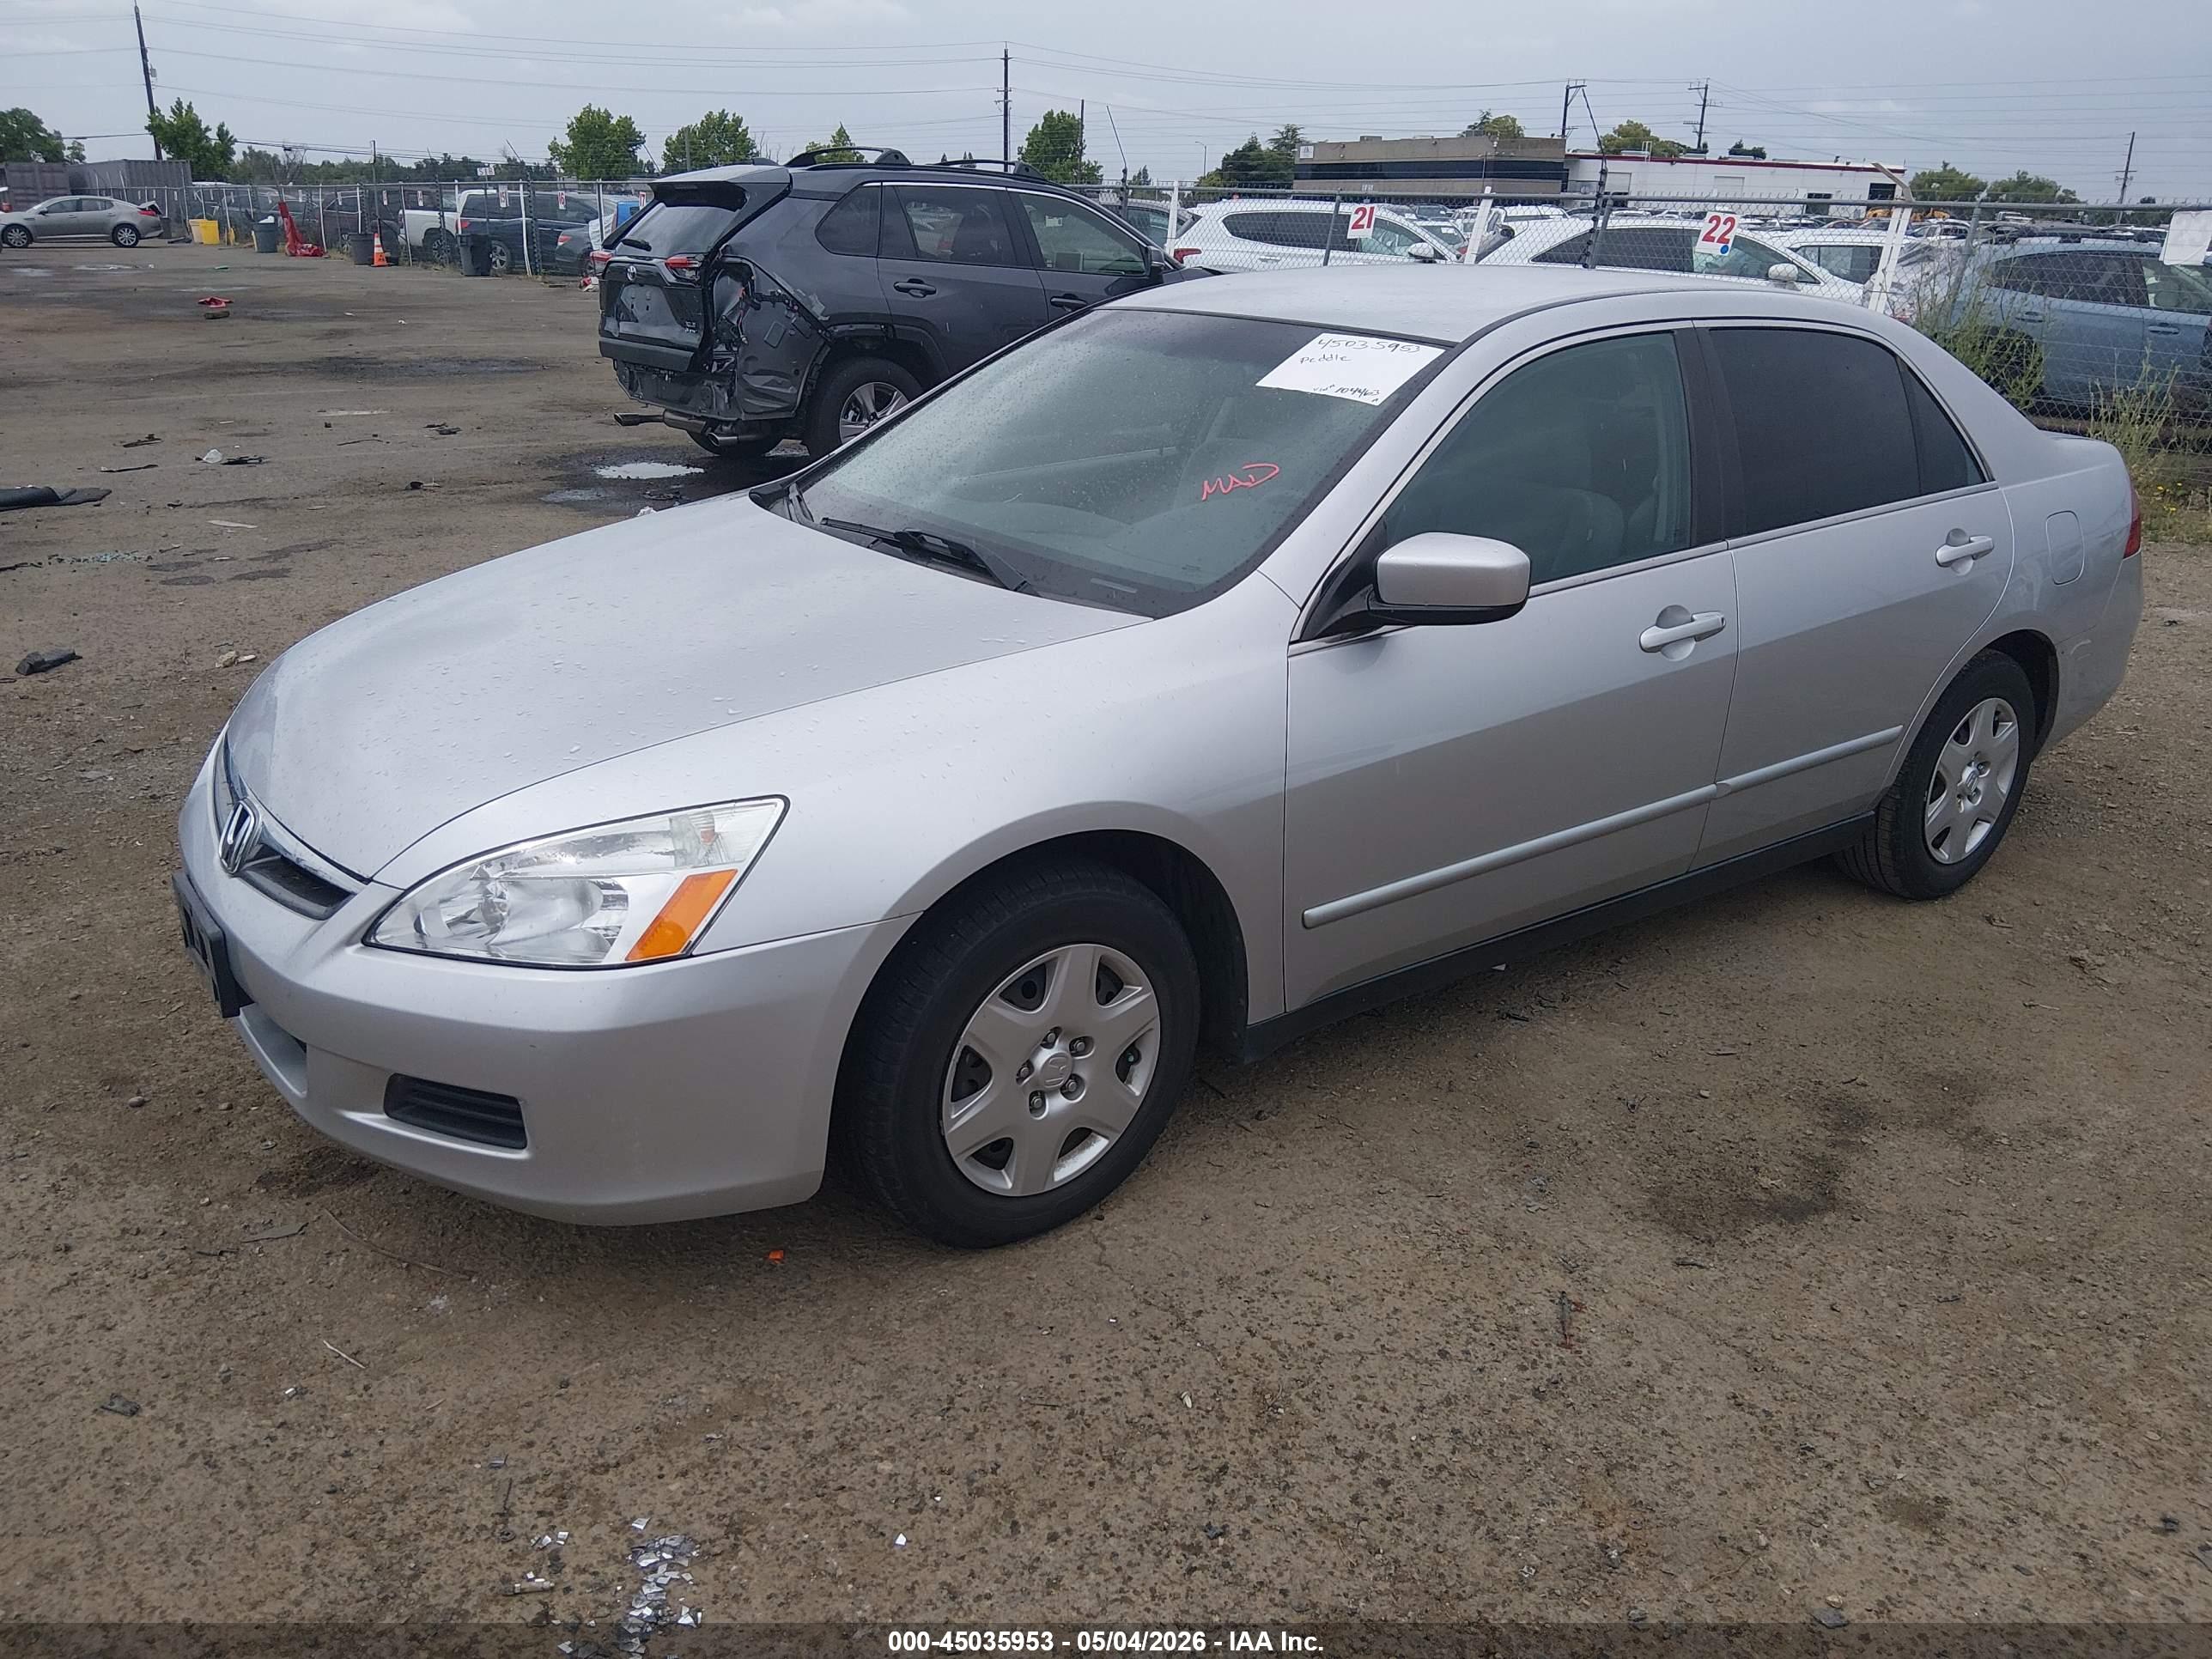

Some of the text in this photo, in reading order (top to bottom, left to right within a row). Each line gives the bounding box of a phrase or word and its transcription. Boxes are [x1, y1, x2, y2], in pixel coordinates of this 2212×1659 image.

[558, 191, 566, 204] 16
[1351, 206, 1375, 229] 21
[1701, 215, 1735, 244] 22
[1201, 463, 1280, 501] MAD
